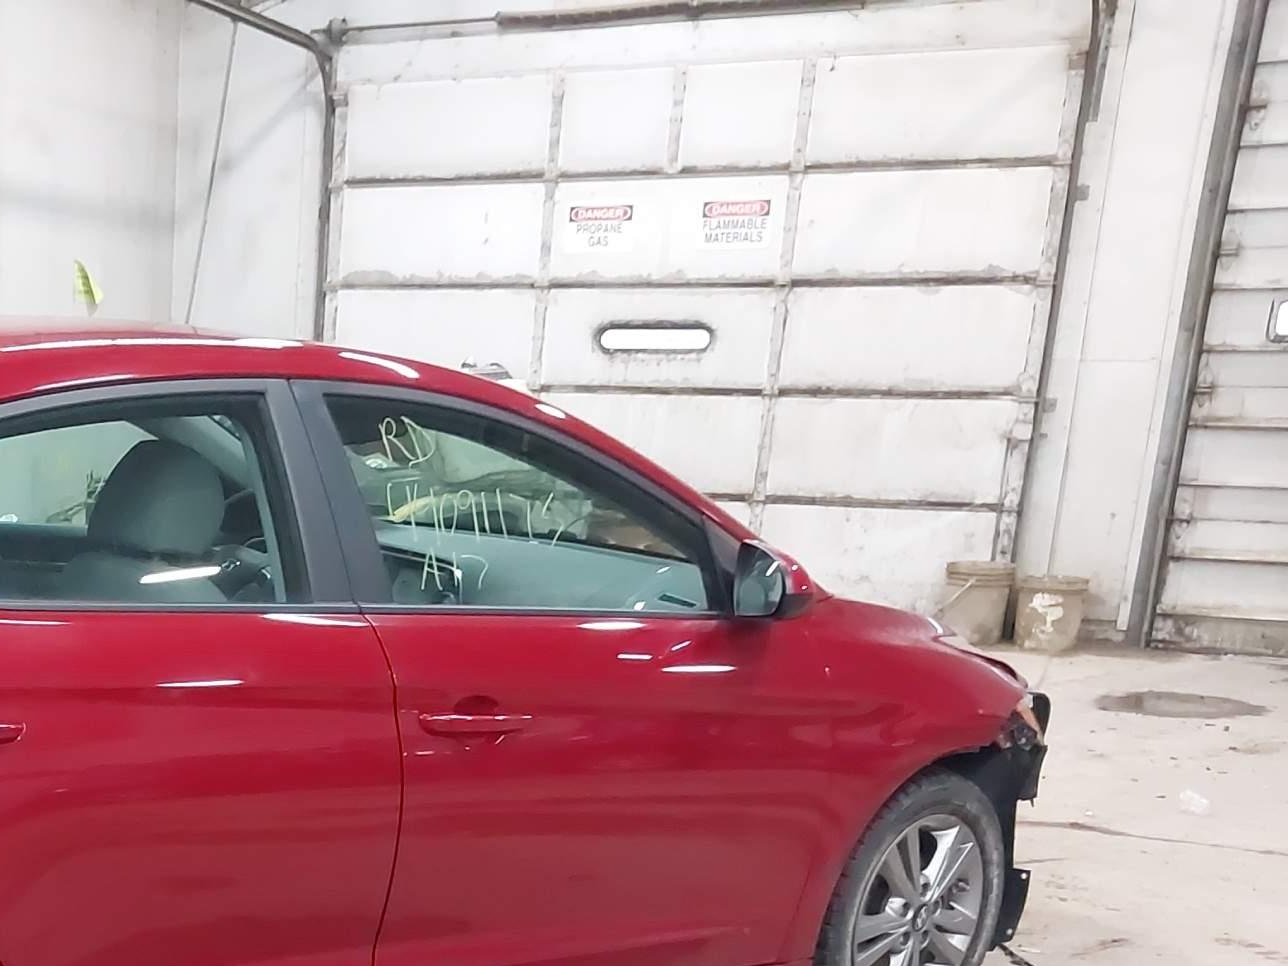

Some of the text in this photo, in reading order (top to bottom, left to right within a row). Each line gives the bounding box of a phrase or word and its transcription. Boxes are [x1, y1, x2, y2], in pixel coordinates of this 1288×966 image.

[577, 208, 624, 220] DANGER
[712, 203, 760, 216] DANGER
[576, 223, 623, 234] PROPANE
[703, 218, 768, 231] FLAMMABLE
[588, 235, 609, 247] GAS
[704, 231, 763, 243] MATERIALS
